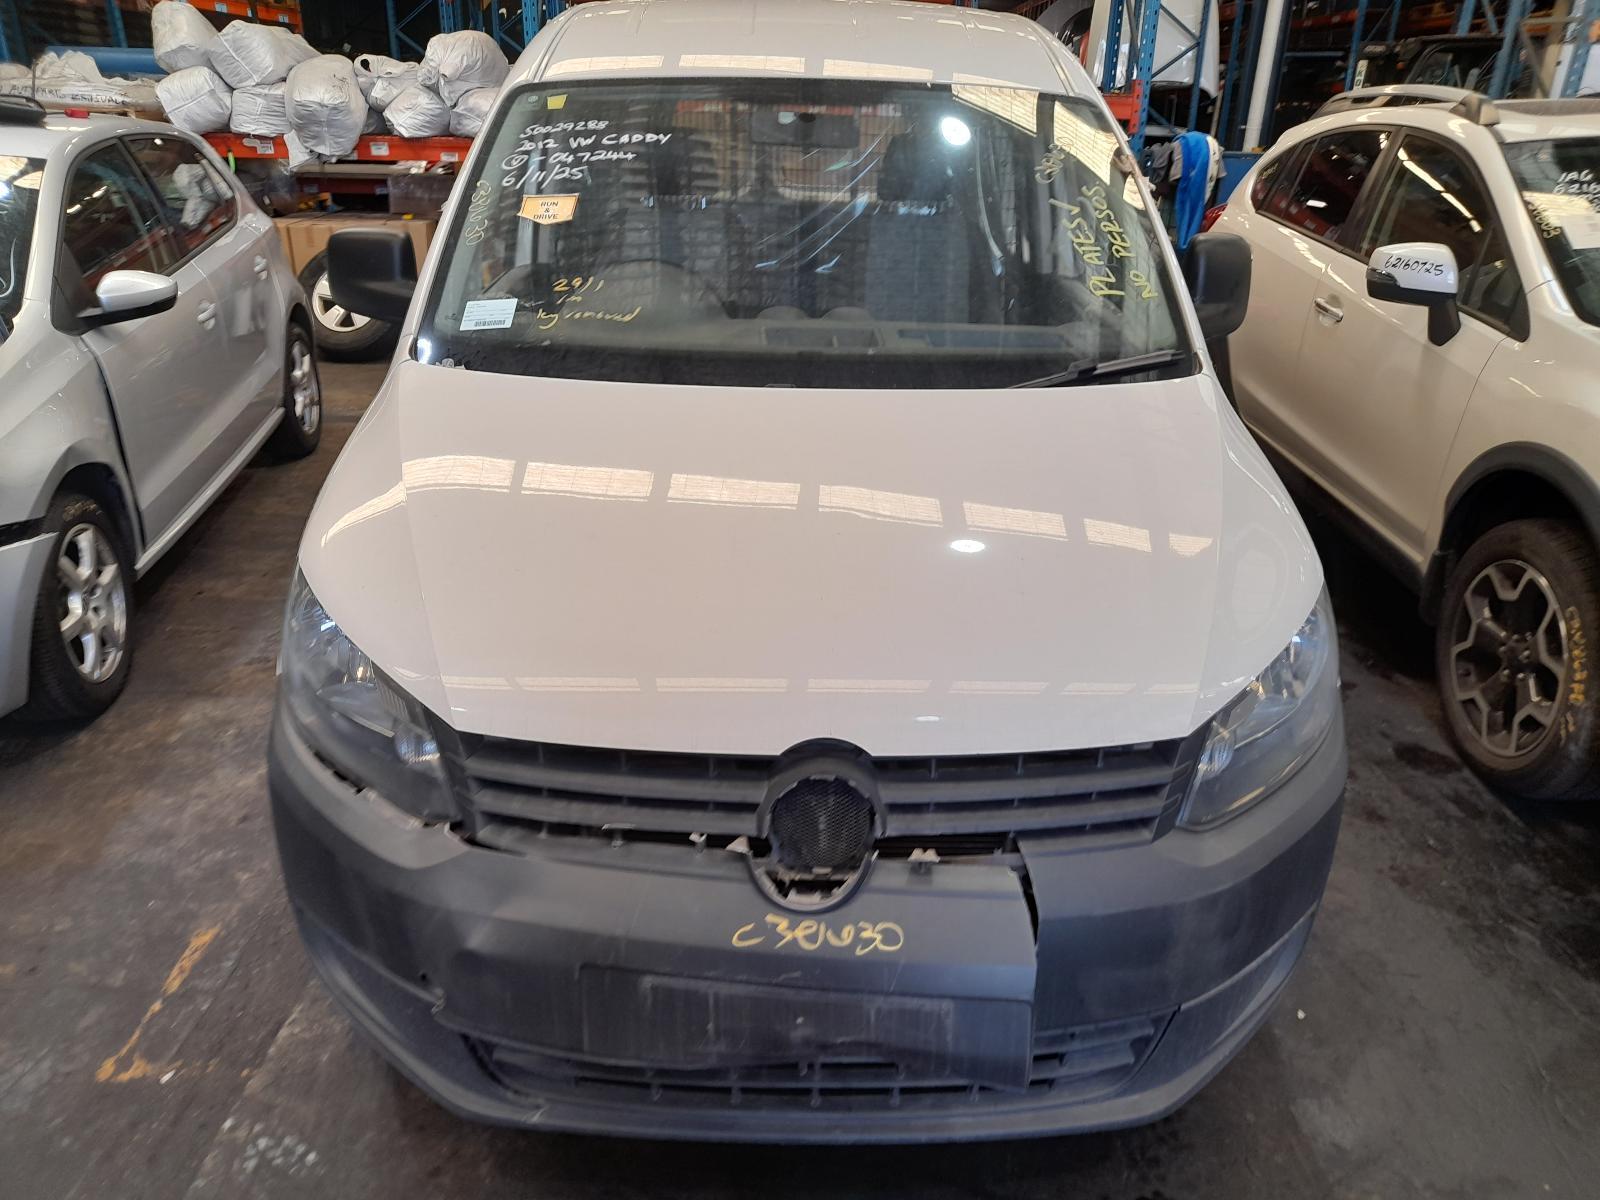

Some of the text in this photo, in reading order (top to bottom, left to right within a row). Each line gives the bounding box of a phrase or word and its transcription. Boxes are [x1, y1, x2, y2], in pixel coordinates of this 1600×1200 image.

[514, 133, 672, 152] 2012 VW CADDY
[1384, 255, 1444, 276] 62160725
[1129, 270, 1159, 299] NO
